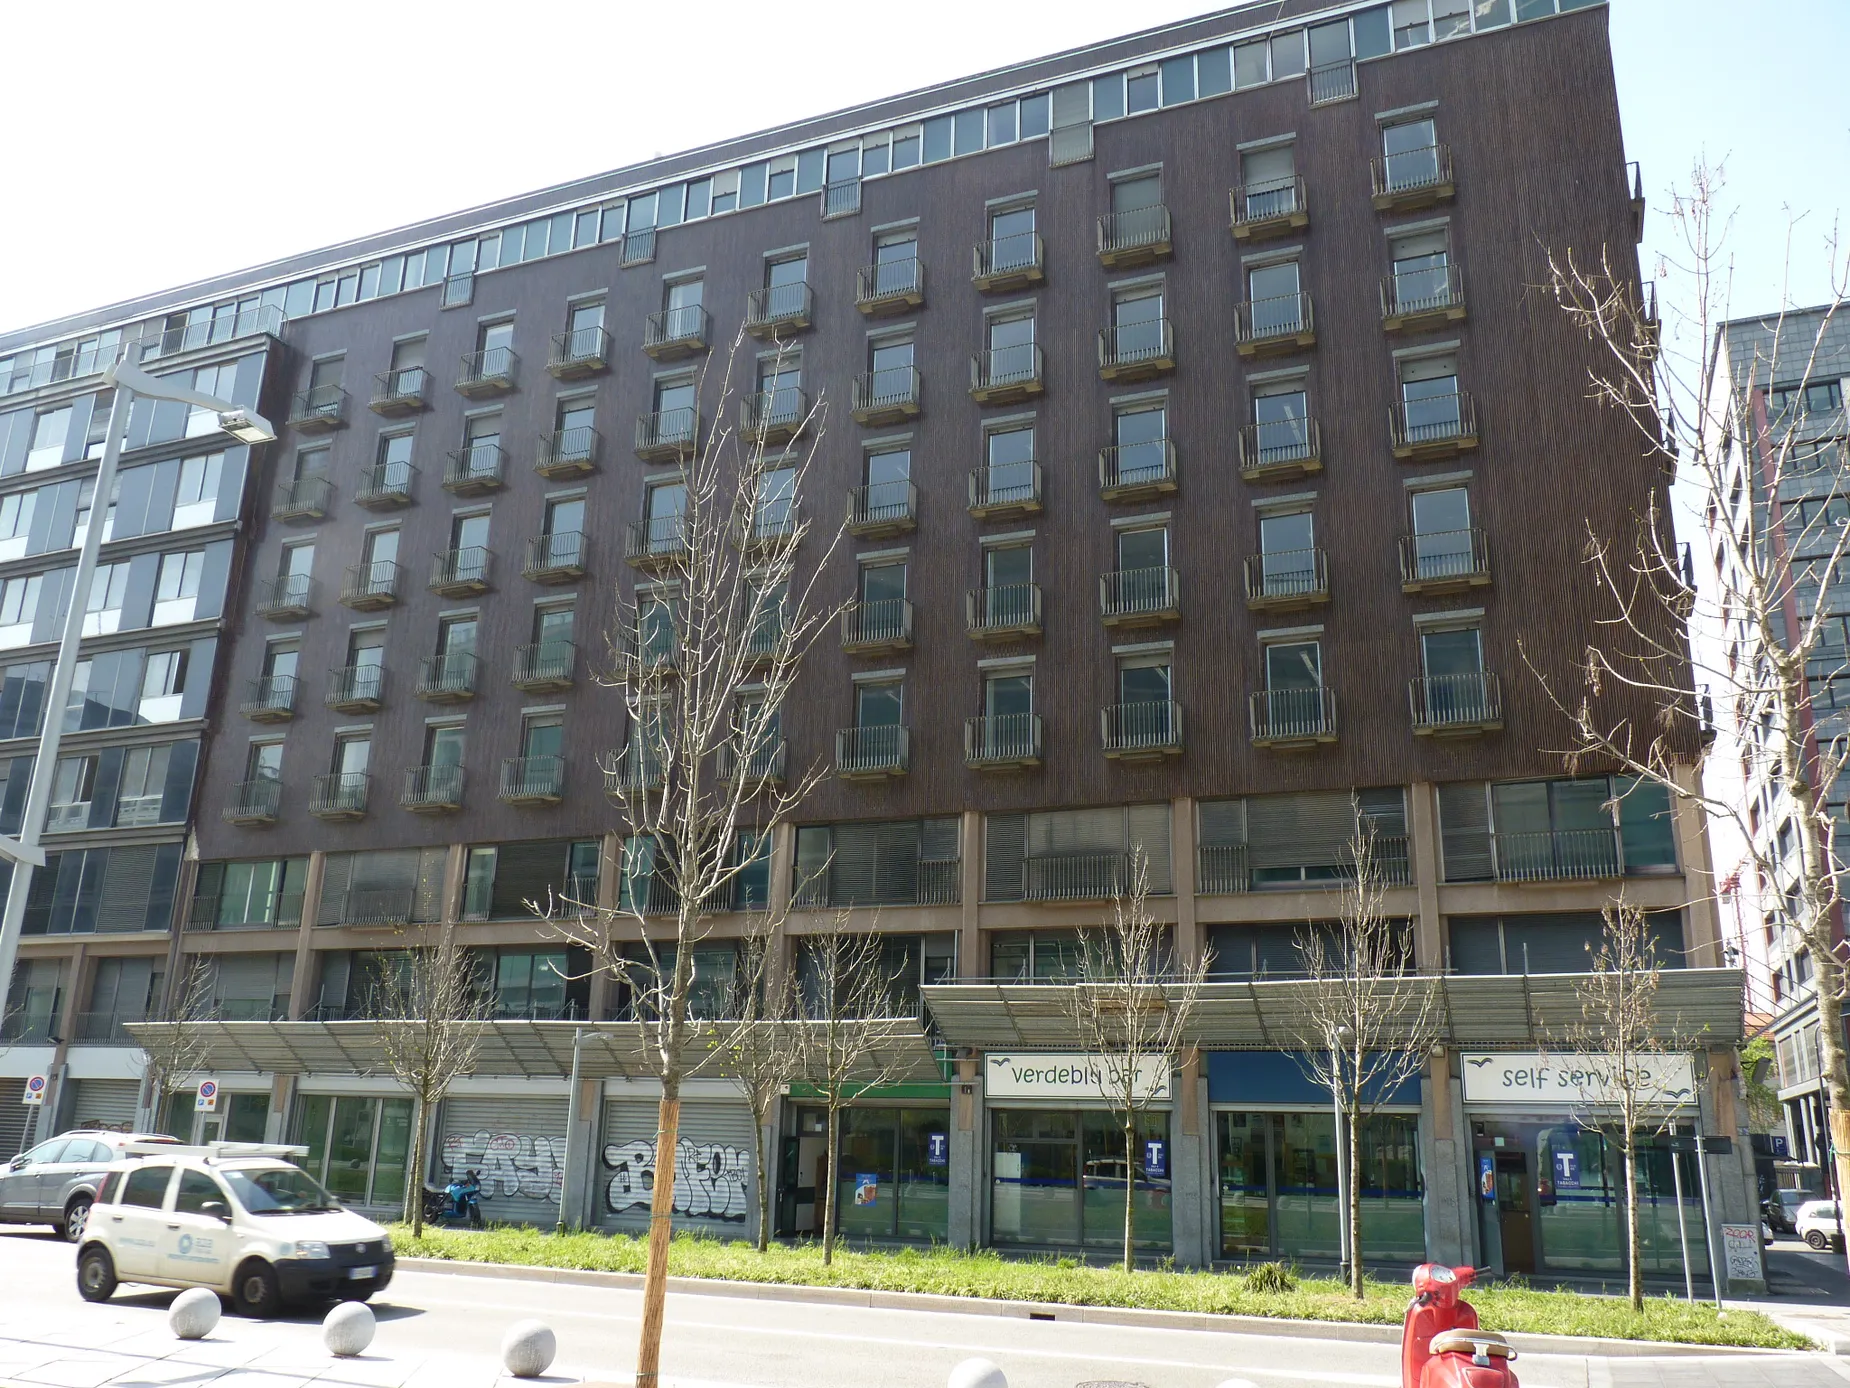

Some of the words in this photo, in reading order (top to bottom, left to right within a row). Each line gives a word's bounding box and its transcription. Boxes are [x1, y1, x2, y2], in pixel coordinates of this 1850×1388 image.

[1502, 1068, 1550, 1089] self
[931, 1135, 944, 1156] T
[1147, 1142, 1162, 1165] T
[1556, 1152, 1574, 1177] T
